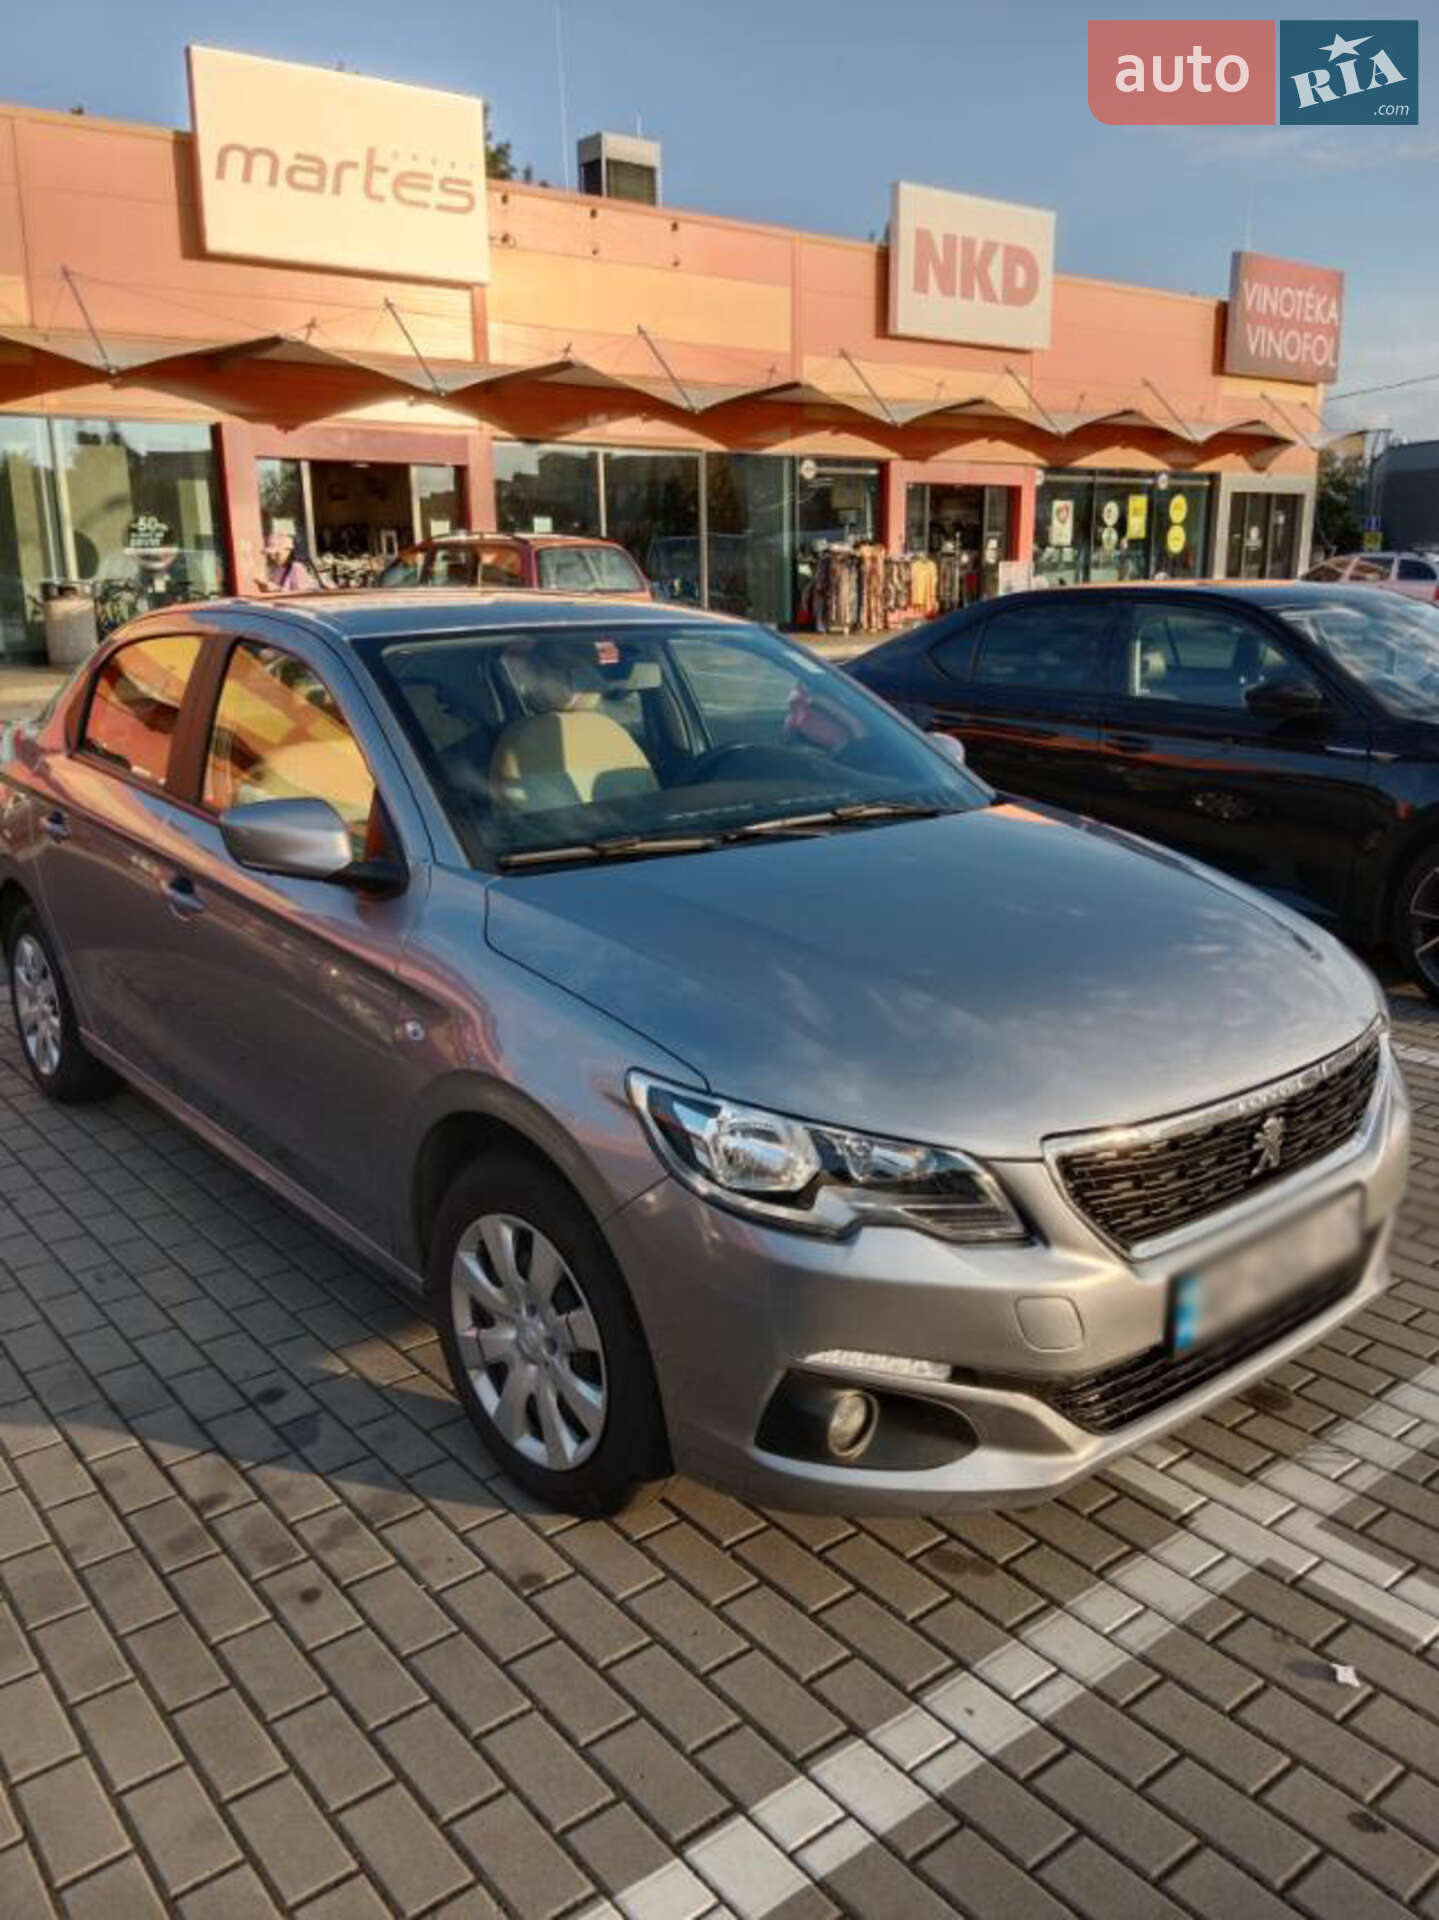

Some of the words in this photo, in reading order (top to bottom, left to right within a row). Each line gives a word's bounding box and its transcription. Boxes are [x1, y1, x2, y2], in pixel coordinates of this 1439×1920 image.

[215, 143, 476, 214] martes
[913, 228, 1040, 307] NKD
[1242, 280, 1339, 325] VINOTÉKA
[1246, 323, 1337, 368] VINOFOL
